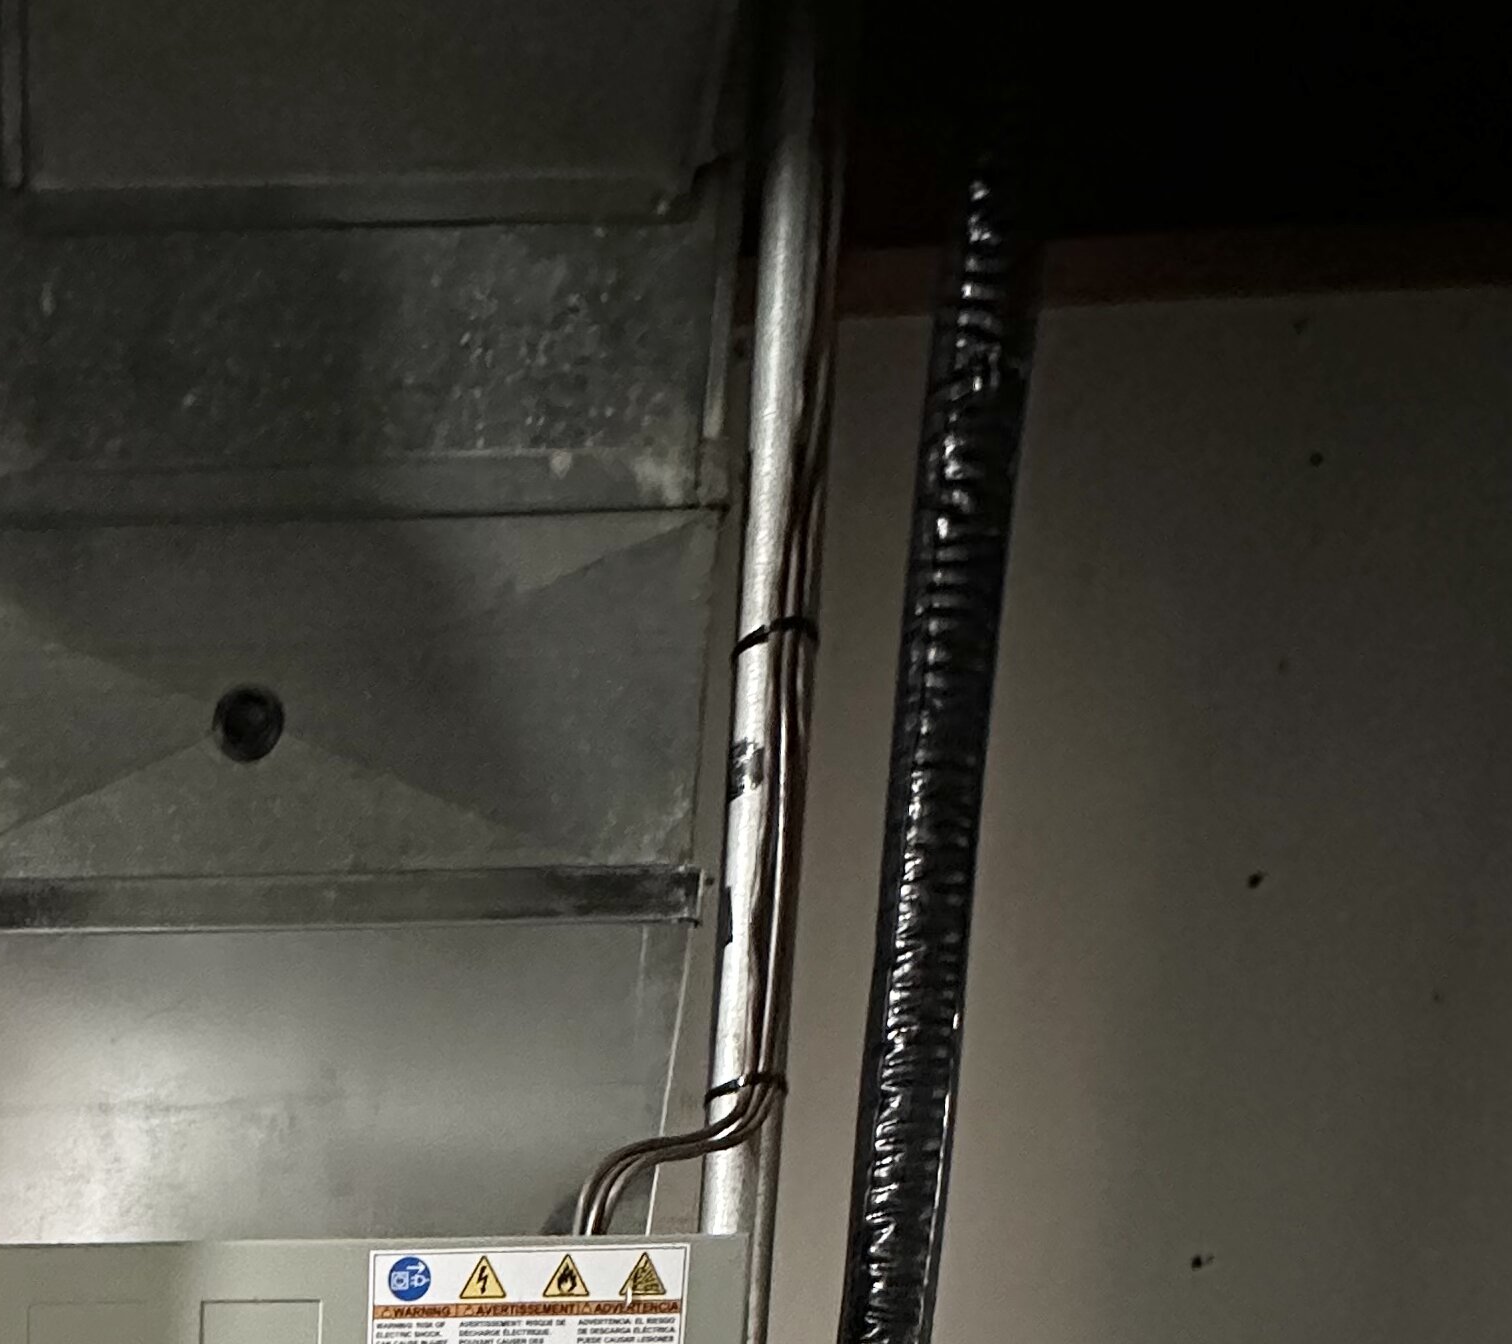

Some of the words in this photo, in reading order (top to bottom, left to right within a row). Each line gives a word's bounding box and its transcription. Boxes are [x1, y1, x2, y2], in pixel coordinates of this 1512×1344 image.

[394, 1307, 450, 1317] WARNING
[476, 1304, 574, 1316] AVERTISSEMENT
[594, 1302, 678, 1313] ADVERTENCIA
